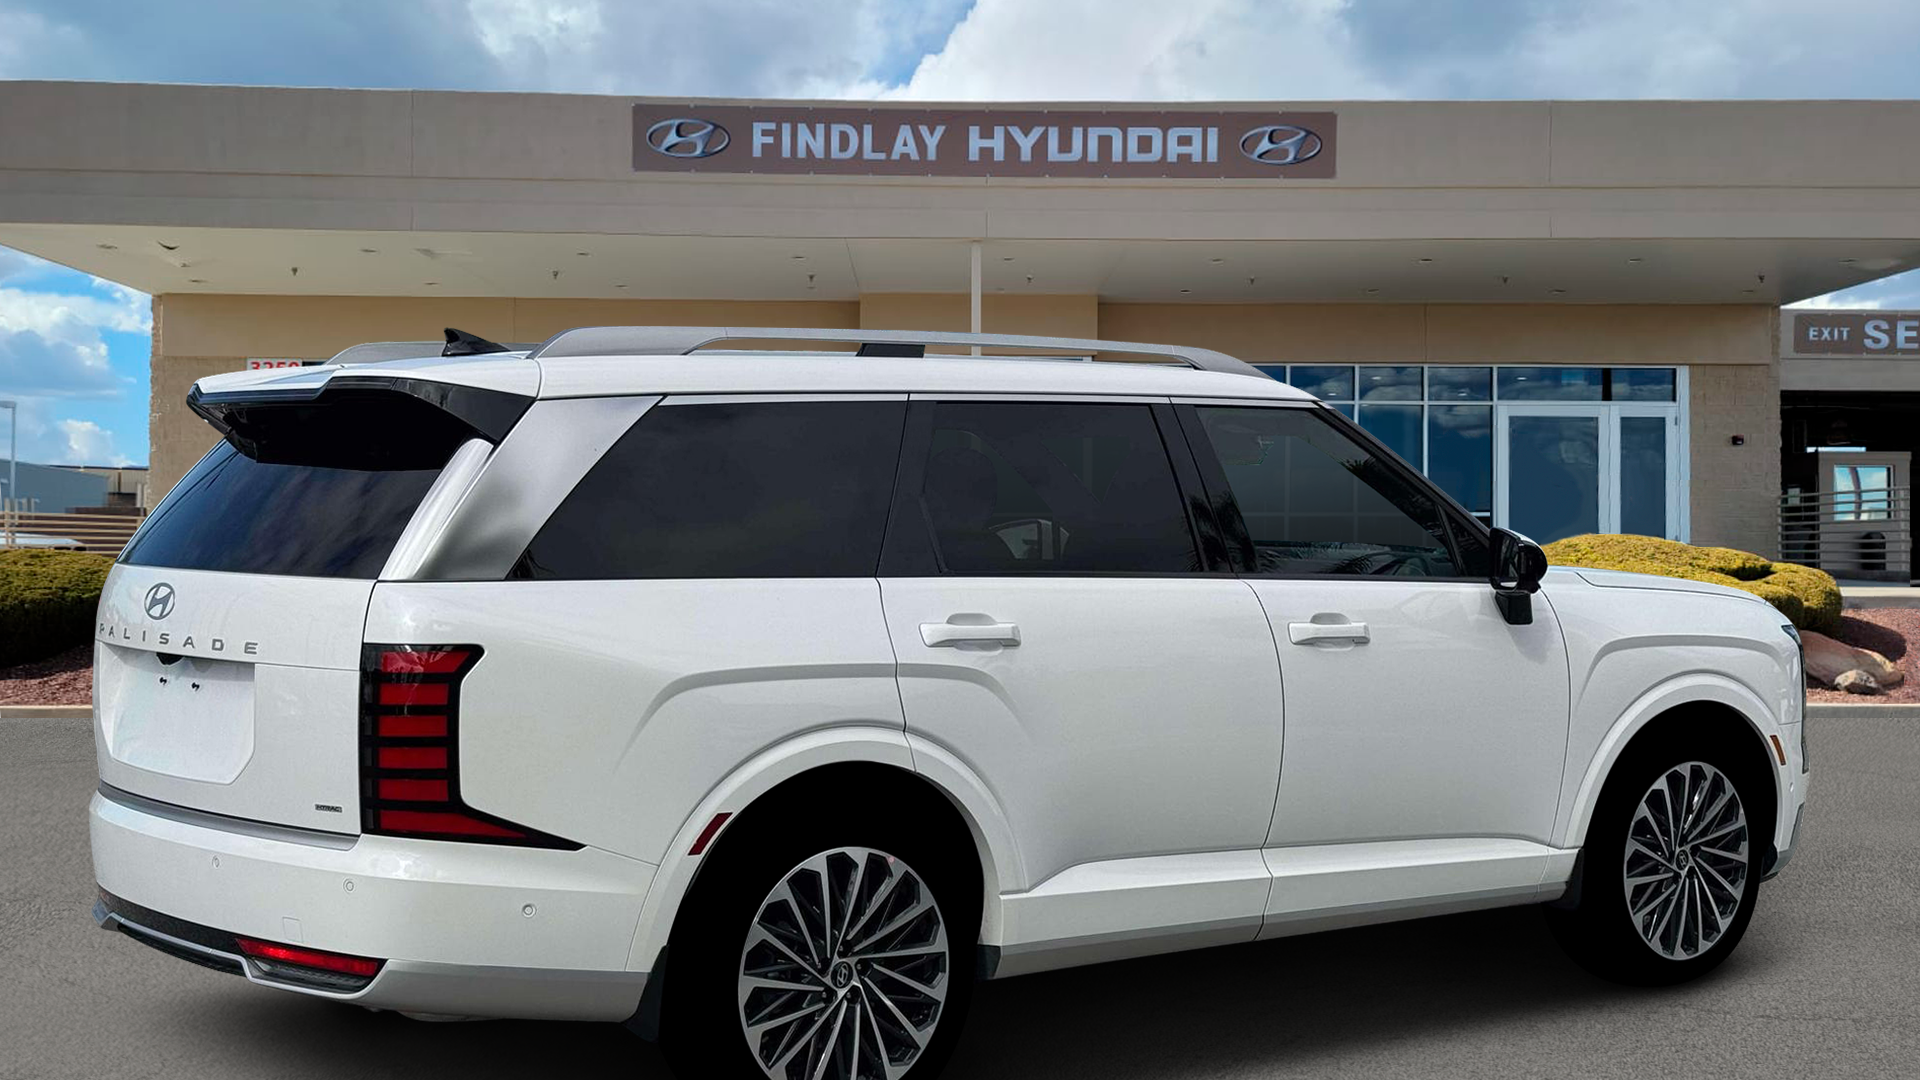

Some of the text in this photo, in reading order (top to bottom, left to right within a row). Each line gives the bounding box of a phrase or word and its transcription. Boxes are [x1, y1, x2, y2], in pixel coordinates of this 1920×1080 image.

[751, 122, 1220, 163] FINDLAY HYUNDAI
[1808, 320, 1920, 349] EXIT SE
[99, 623, 259, 655] PALISADE
